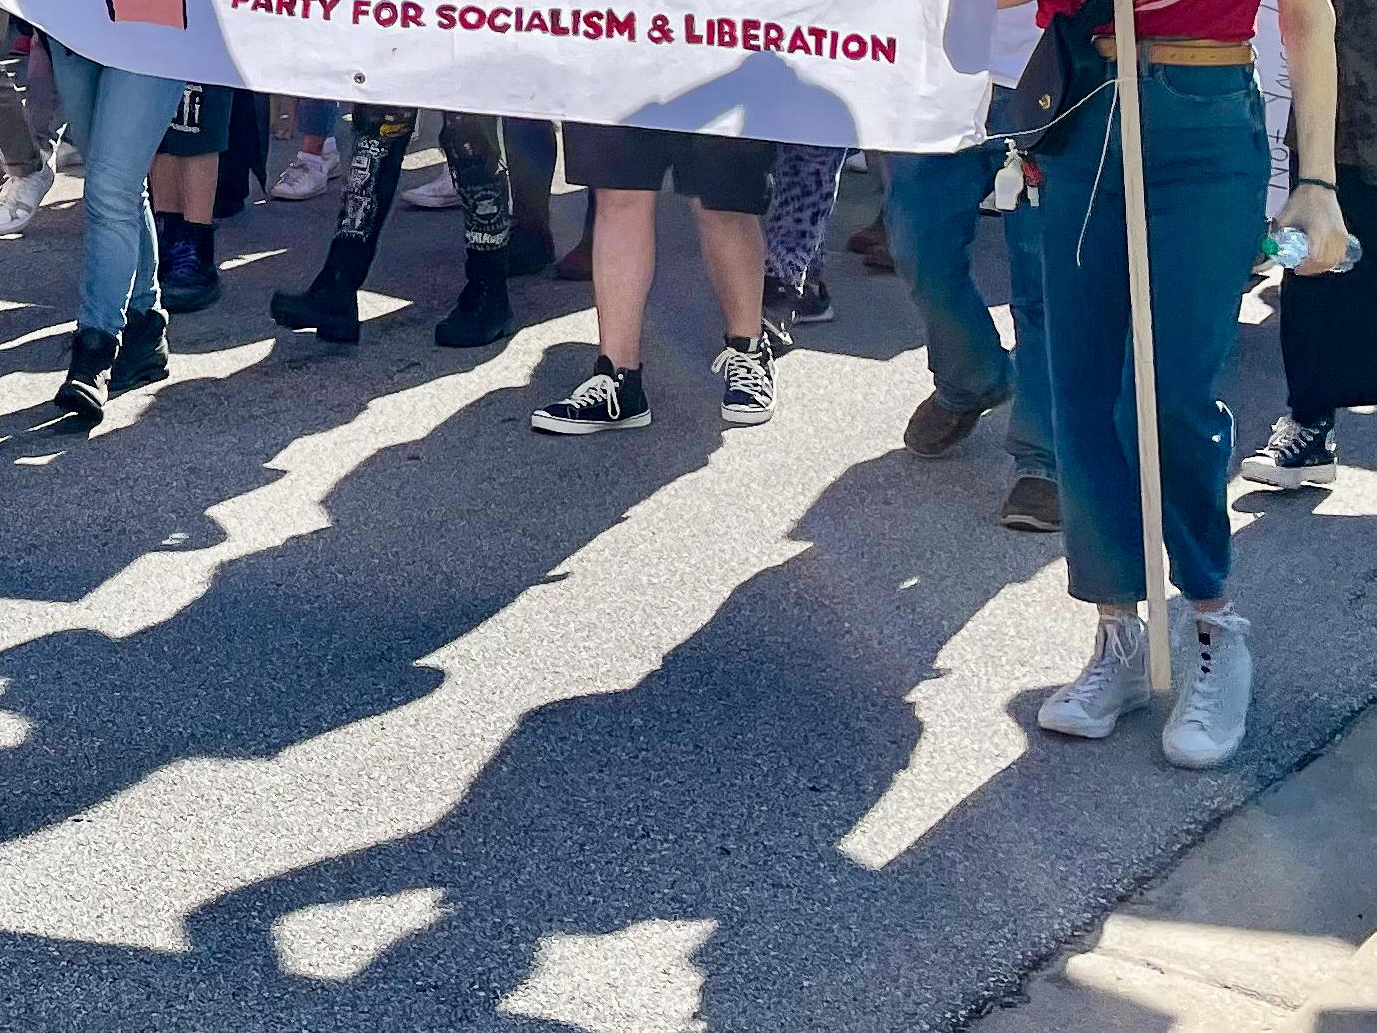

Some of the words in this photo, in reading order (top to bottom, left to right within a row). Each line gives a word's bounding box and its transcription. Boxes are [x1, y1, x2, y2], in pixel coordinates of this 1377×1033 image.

[436, 3, 637, 44] SOCIALISM
[646, 17, 676, 46] &
[683, 13, 898, 65] LIBERATION
